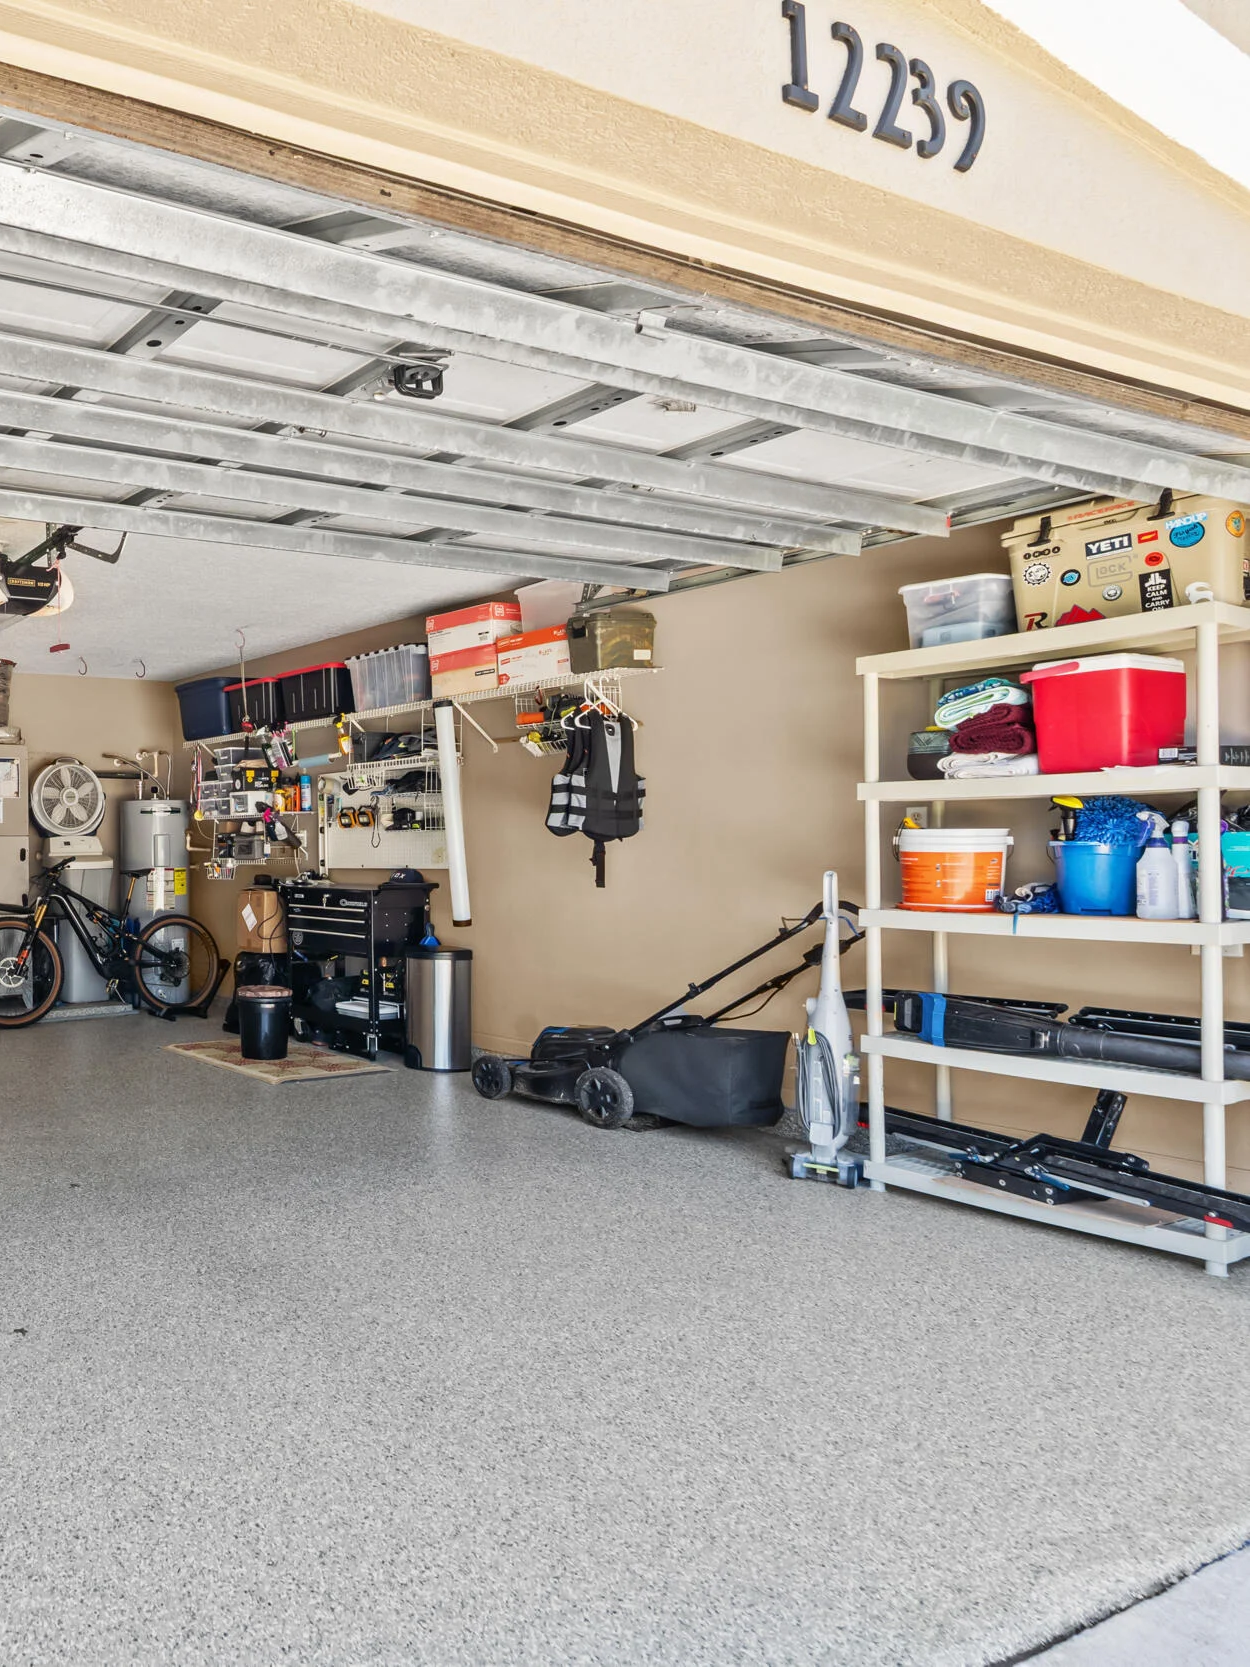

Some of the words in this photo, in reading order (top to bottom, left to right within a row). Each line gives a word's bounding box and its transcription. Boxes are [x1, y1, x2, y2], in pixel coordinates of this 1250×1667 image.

[781, 0, 986, 172] 12239
[1087, 535, 1130, 554] YETI
[1147, 584, 1166, 592] KEEP
[1145, 589, 1168, 598] CALM
[1145, 599, 1170, 608] CARRY
